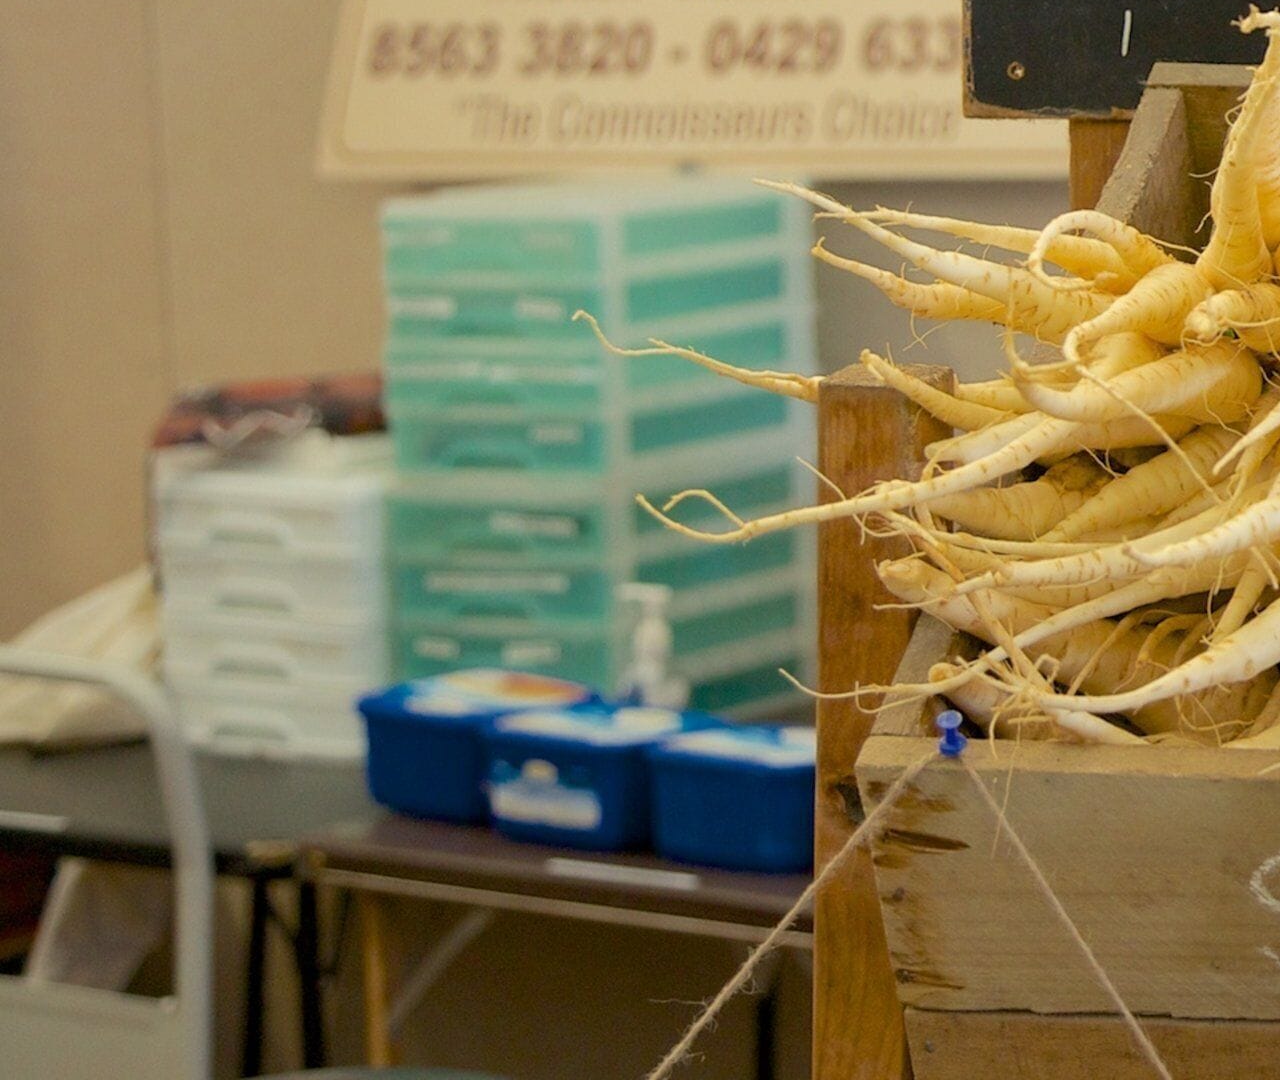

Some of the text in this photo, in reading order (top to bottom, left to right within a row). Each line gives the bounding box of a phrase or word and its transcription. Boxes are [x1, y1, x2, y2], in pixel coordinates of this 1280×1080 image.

[369, 21, 498, 75] 8563
[519, 19, 654, 74] 3820
[706, 17, 845, 72] 0429
